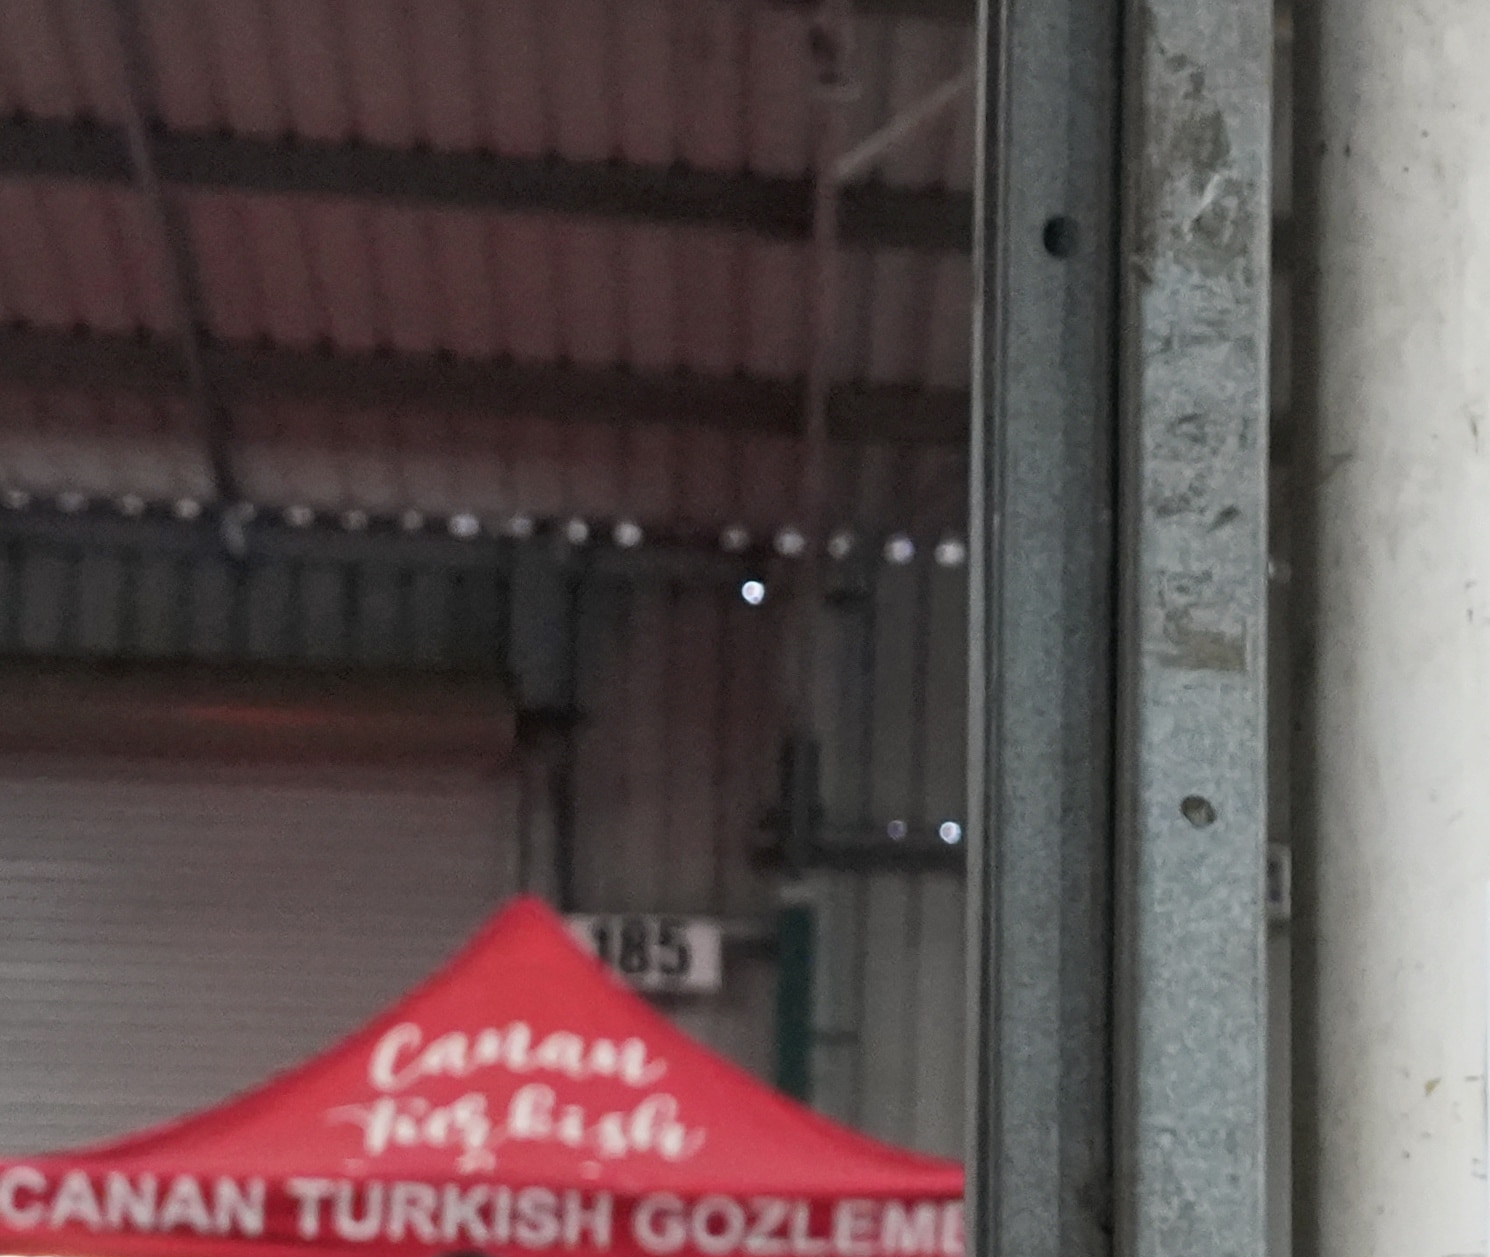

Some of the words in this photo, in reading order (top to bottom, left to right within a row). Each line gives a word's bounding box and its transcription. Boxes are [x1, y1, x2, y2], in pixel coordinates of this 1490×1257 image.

[591, 916, 692, 975] 185
[366, 1020, 669, 1093] Canan
[0, 1165, 267, 1237] CANAN
[285, 1175, 614, 1254] TURKISH
